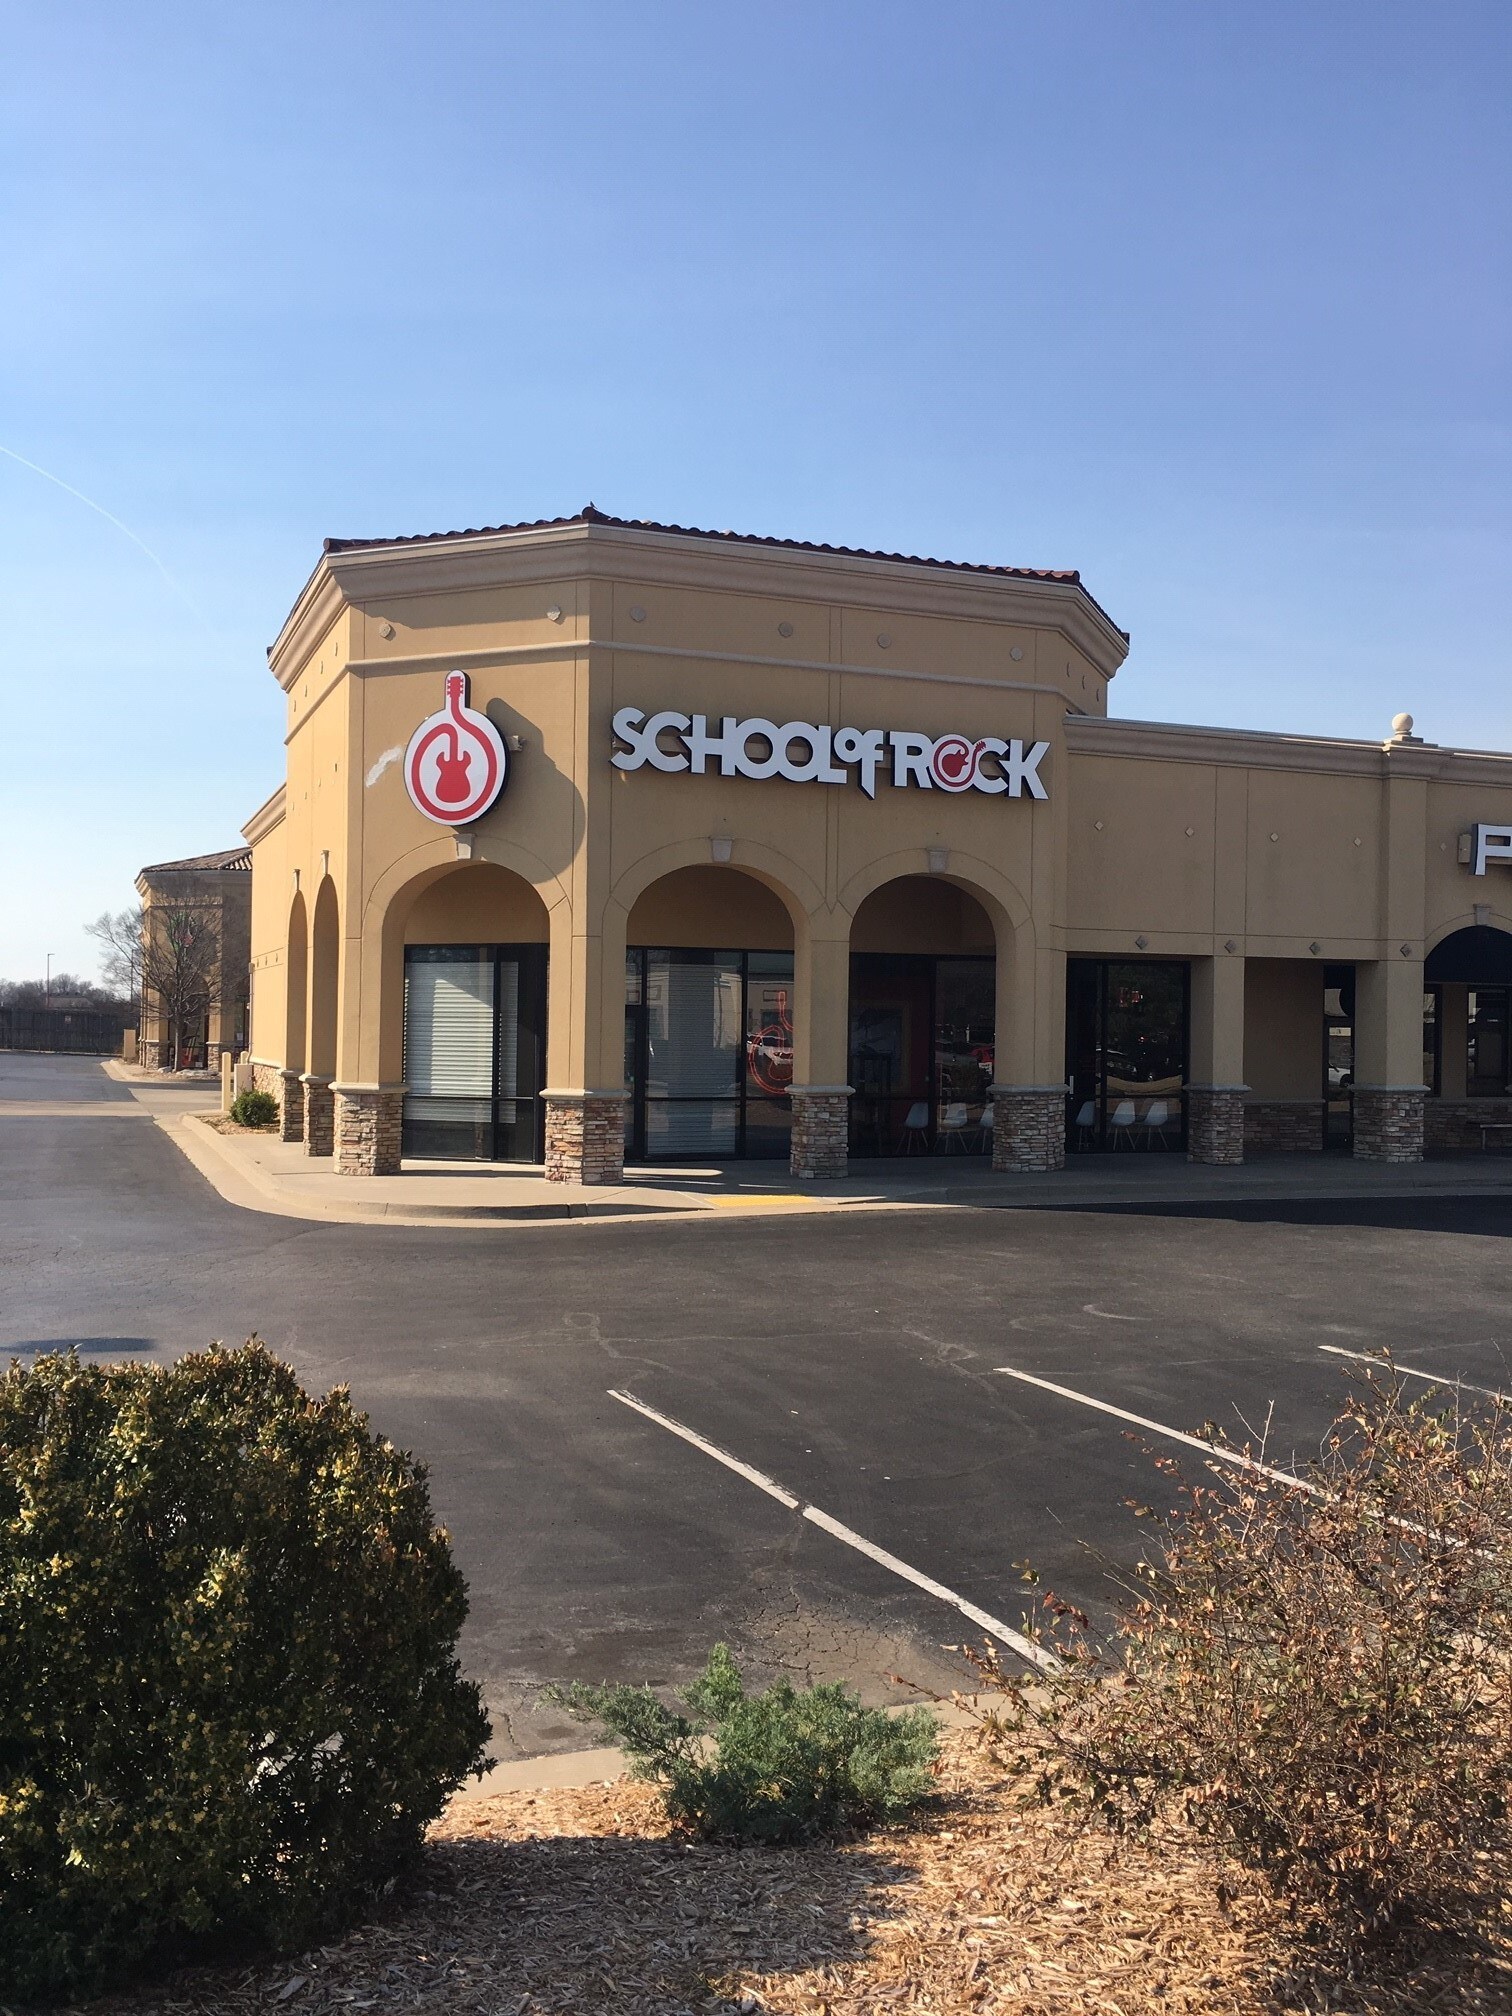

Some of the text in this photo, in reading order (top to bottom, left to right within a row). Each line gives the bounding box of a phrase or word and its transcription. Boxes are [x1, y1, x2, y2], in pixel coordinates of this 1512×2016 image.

[610, 707, 1051, 800] SCHOOL of ROCK
